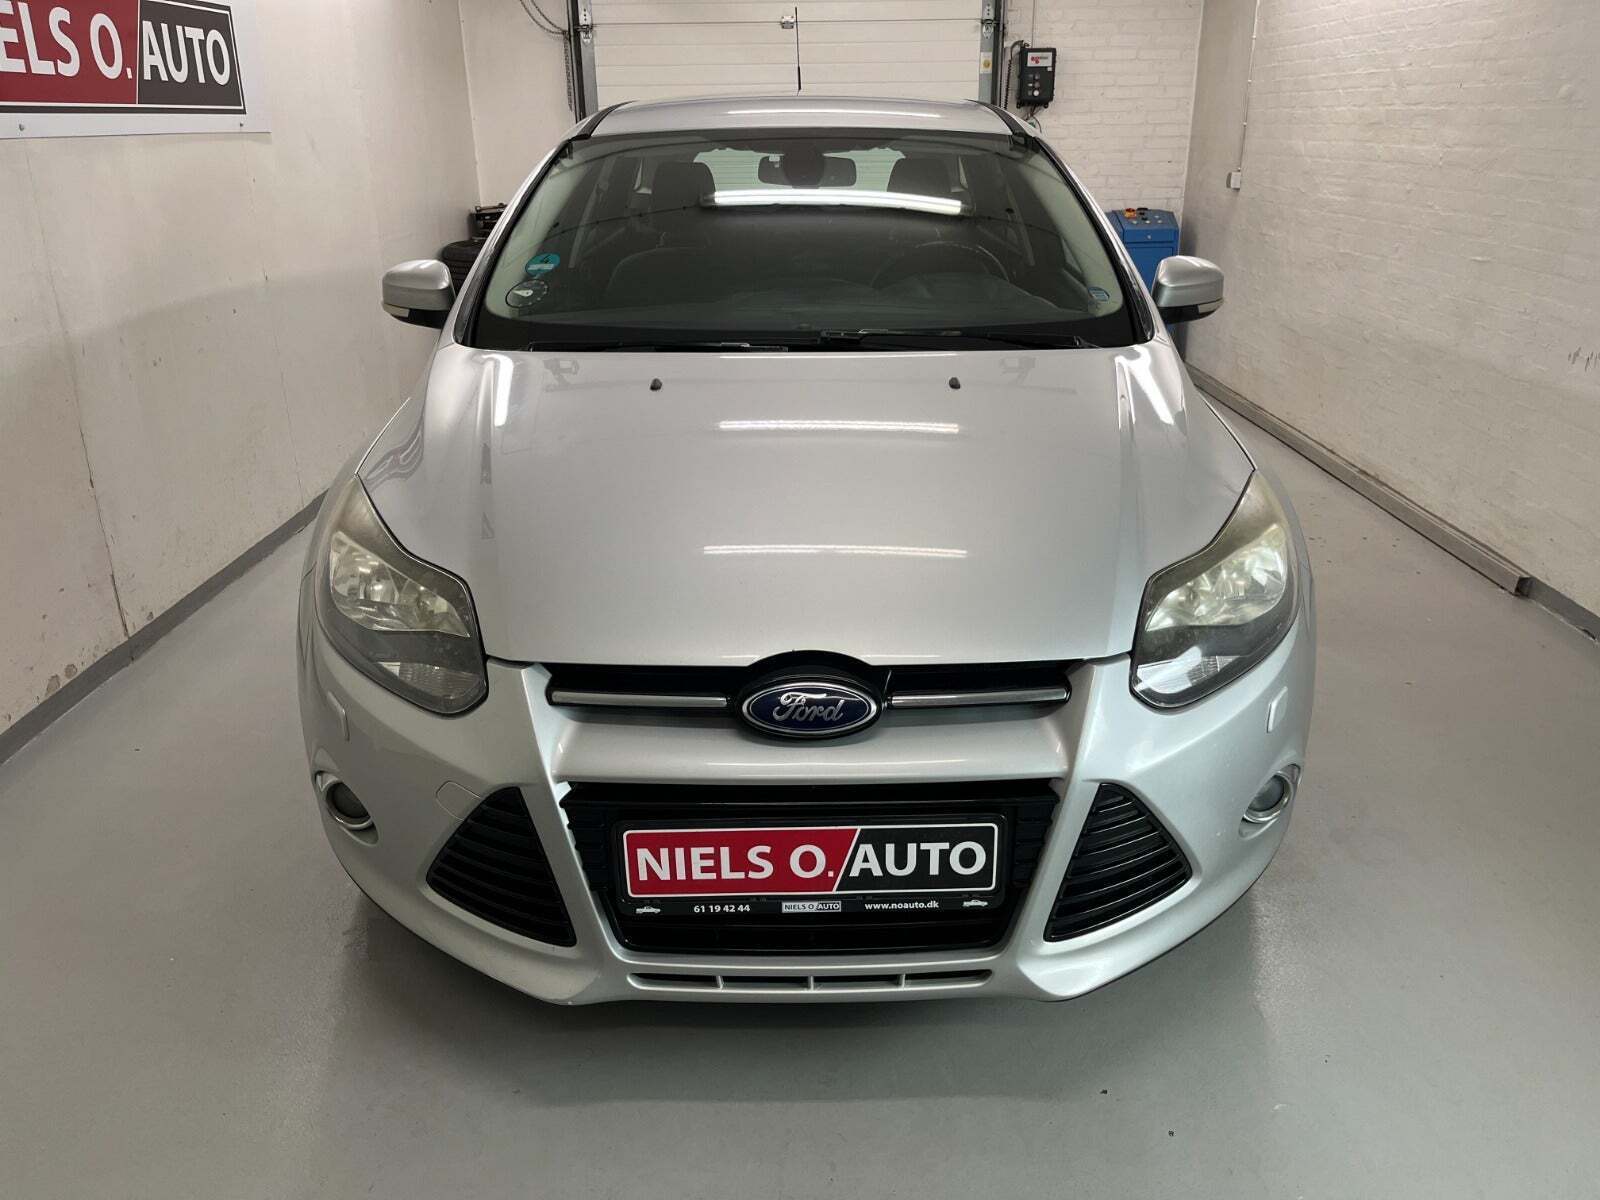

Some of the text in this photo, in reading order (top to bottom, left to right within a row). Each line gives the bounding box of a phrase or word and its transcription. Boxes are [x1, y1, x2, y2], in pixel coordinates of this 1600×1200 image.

[90, 13, 133, 80] O.
[142, 20, 231, 86] AUTO
[773, 691, 845, 721] Ford
[636, 840, 987, 881] NIELS O. AUTO
[693, 904, 751, 913] 61 19 42 44
[864, 900, 939, 910] www.noauto.dk
